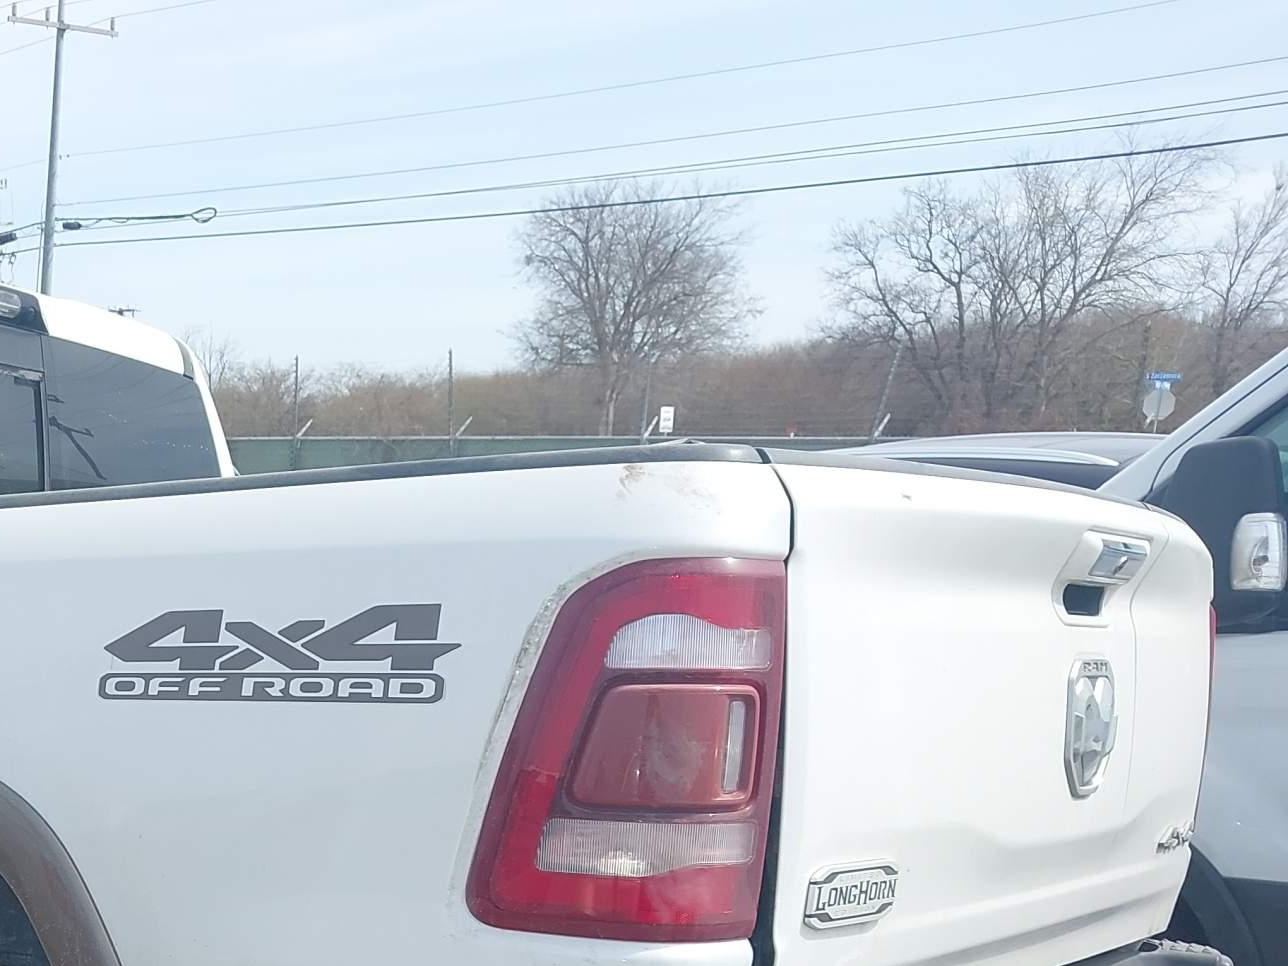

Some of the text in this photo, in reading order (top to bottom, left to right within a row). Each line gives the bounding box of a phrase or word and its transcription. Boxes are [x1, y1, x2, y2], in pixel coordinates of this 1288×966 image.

[1082, 661, 1109, 673] RAM
[104, 676, 437, 699] OFF ROAD
